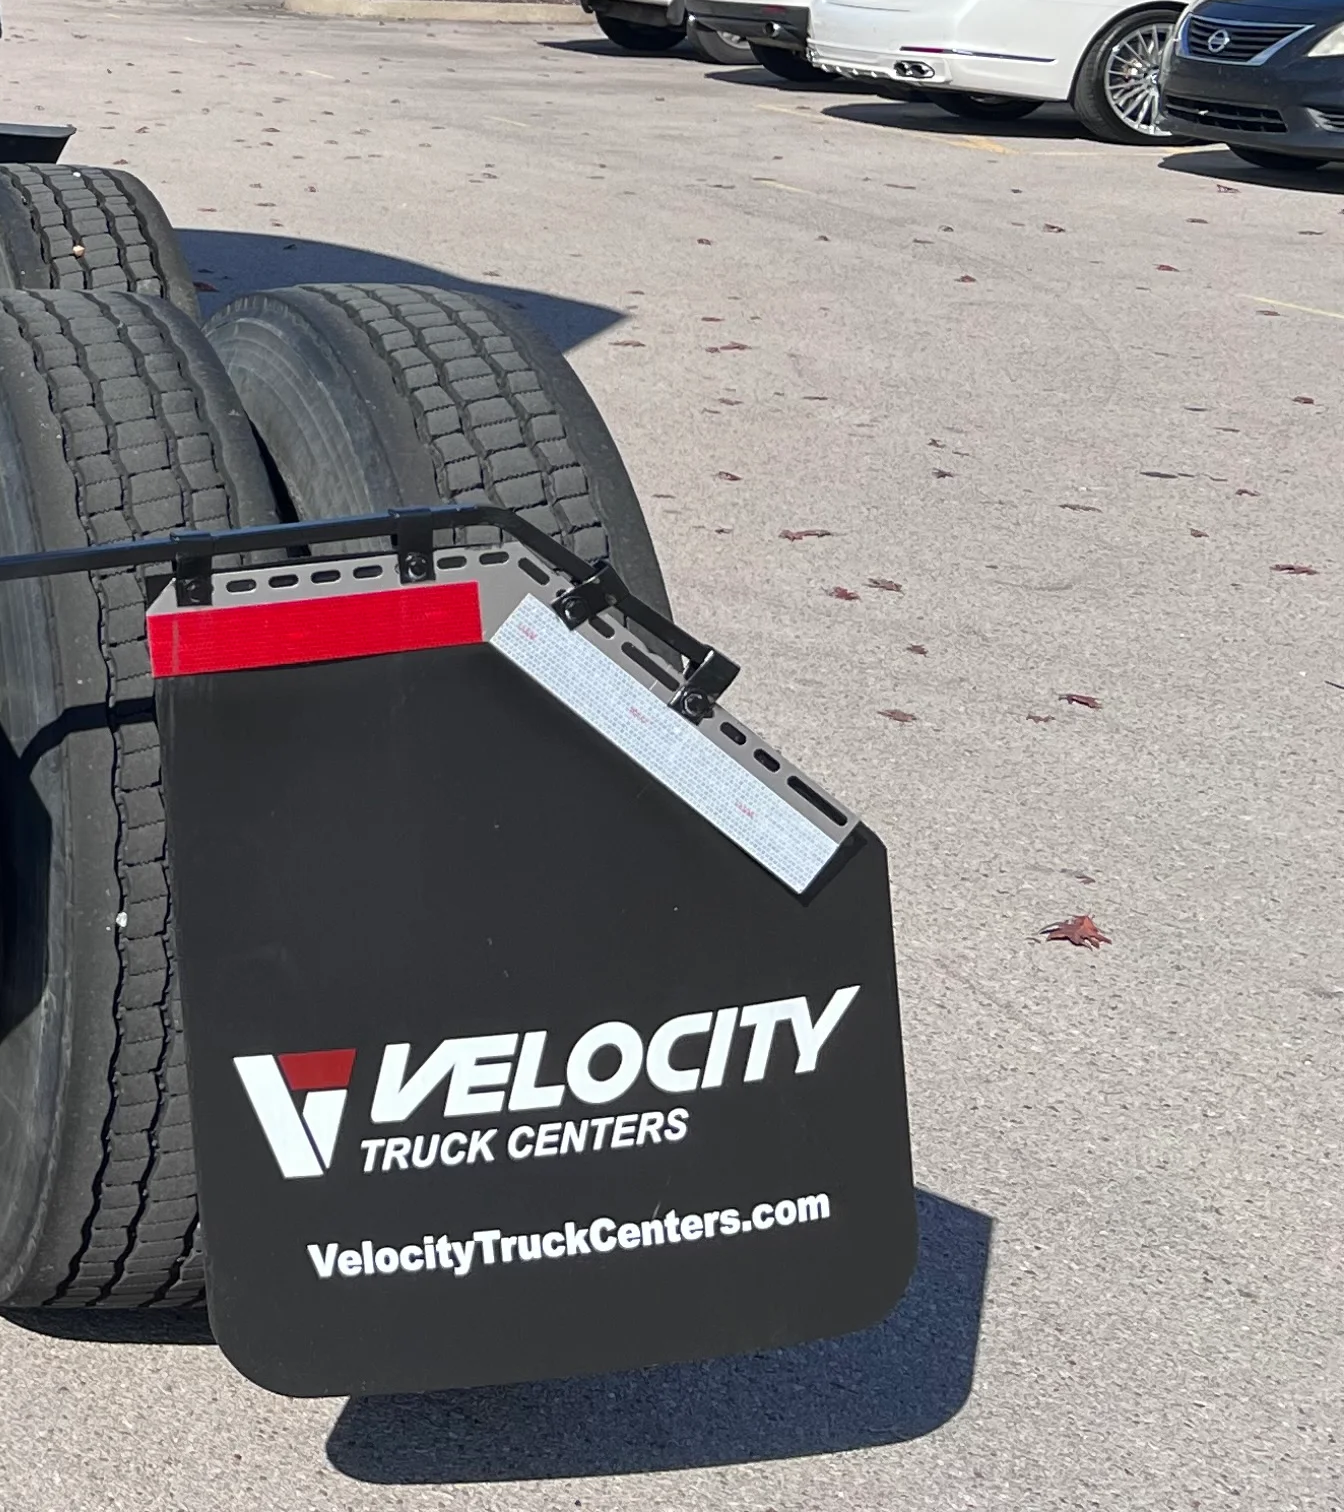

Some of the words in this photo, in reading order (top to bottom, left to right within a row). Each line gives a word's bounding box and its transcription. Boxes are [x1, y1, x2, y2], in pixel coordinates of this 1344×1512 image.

[369, 984, 861, 1124] VELOCITY
[360, 1127, 498, 1174] TRUCK
[507, 1106, 691, 1160] CENTERS
[306, 1190, 831, 1279] VelocityTruckCenters.com
